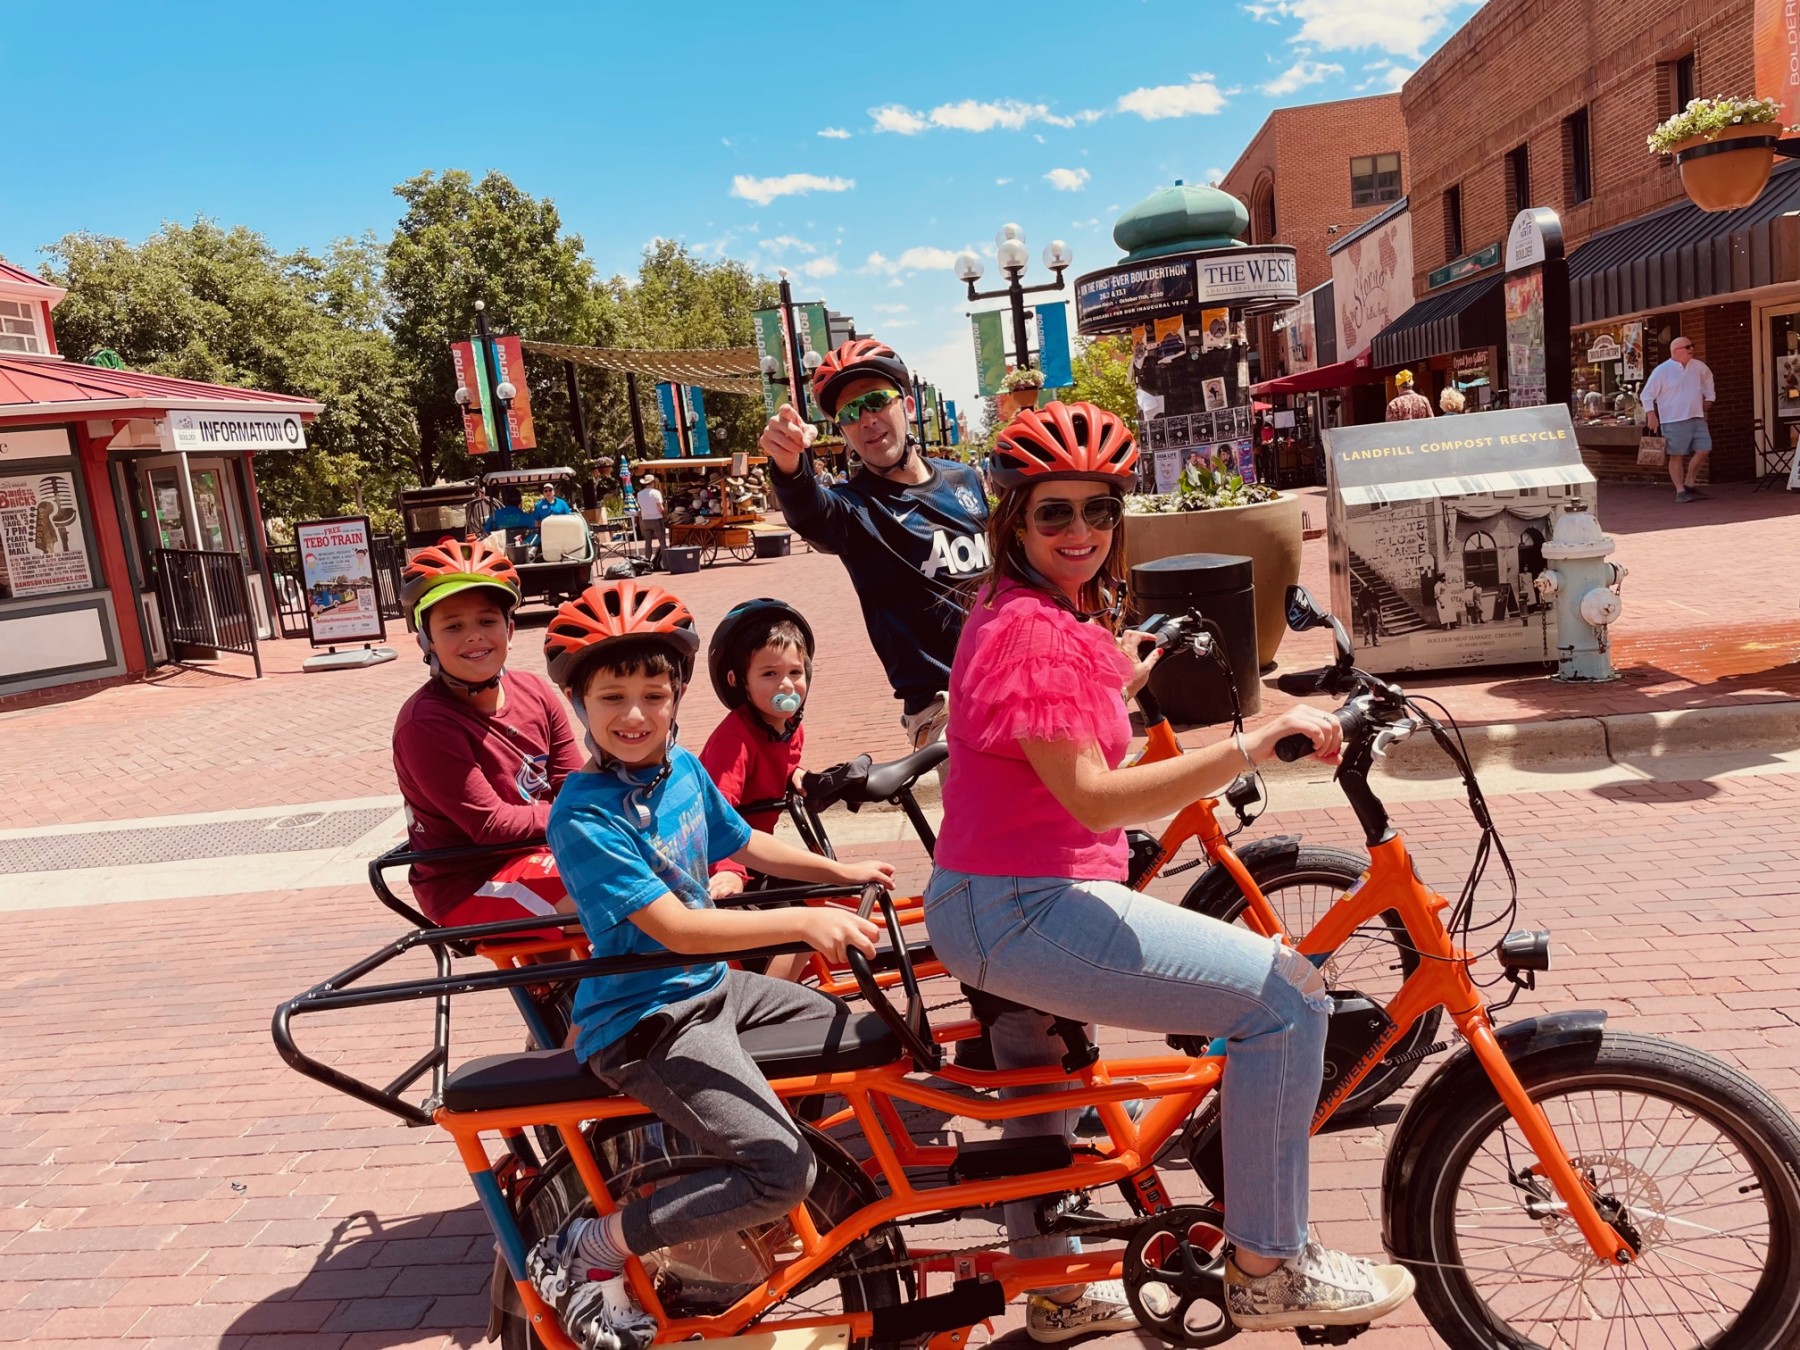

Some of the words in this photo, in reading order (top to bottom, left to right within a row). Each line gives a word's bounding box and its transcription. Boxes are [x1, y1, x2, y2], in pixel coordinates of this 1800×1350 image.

[1516, 246, 1532, 262] BOULDER
[1130, 264, 1187, 284] BOULDERTHON
[1204, 264, 1246, 284] THE
[1136, 303, 1170, 313] INAUGURAL
[199, 421, 283, 442] INFORMATION
[1342, 444, 1414, 462] LANDFILL
[1420, 437, 1492, 452] COMPOST
[1500, 430, 1566, 446] RECYCLE
[4, 528, 9, 536] 7
[12, 526, 28, 536] PM
[324, 526, 342, 535] FREE
[304, 536, 330, 548] TEBO
[331, 533, 363, 546] TRAIN
[8, 548, 30, 556] MALL
[920, 530, 990, 578] AON
[1327, 1060, 1366, 1106] POWER
[1366, 1023, 1398, 1057] BIKES
